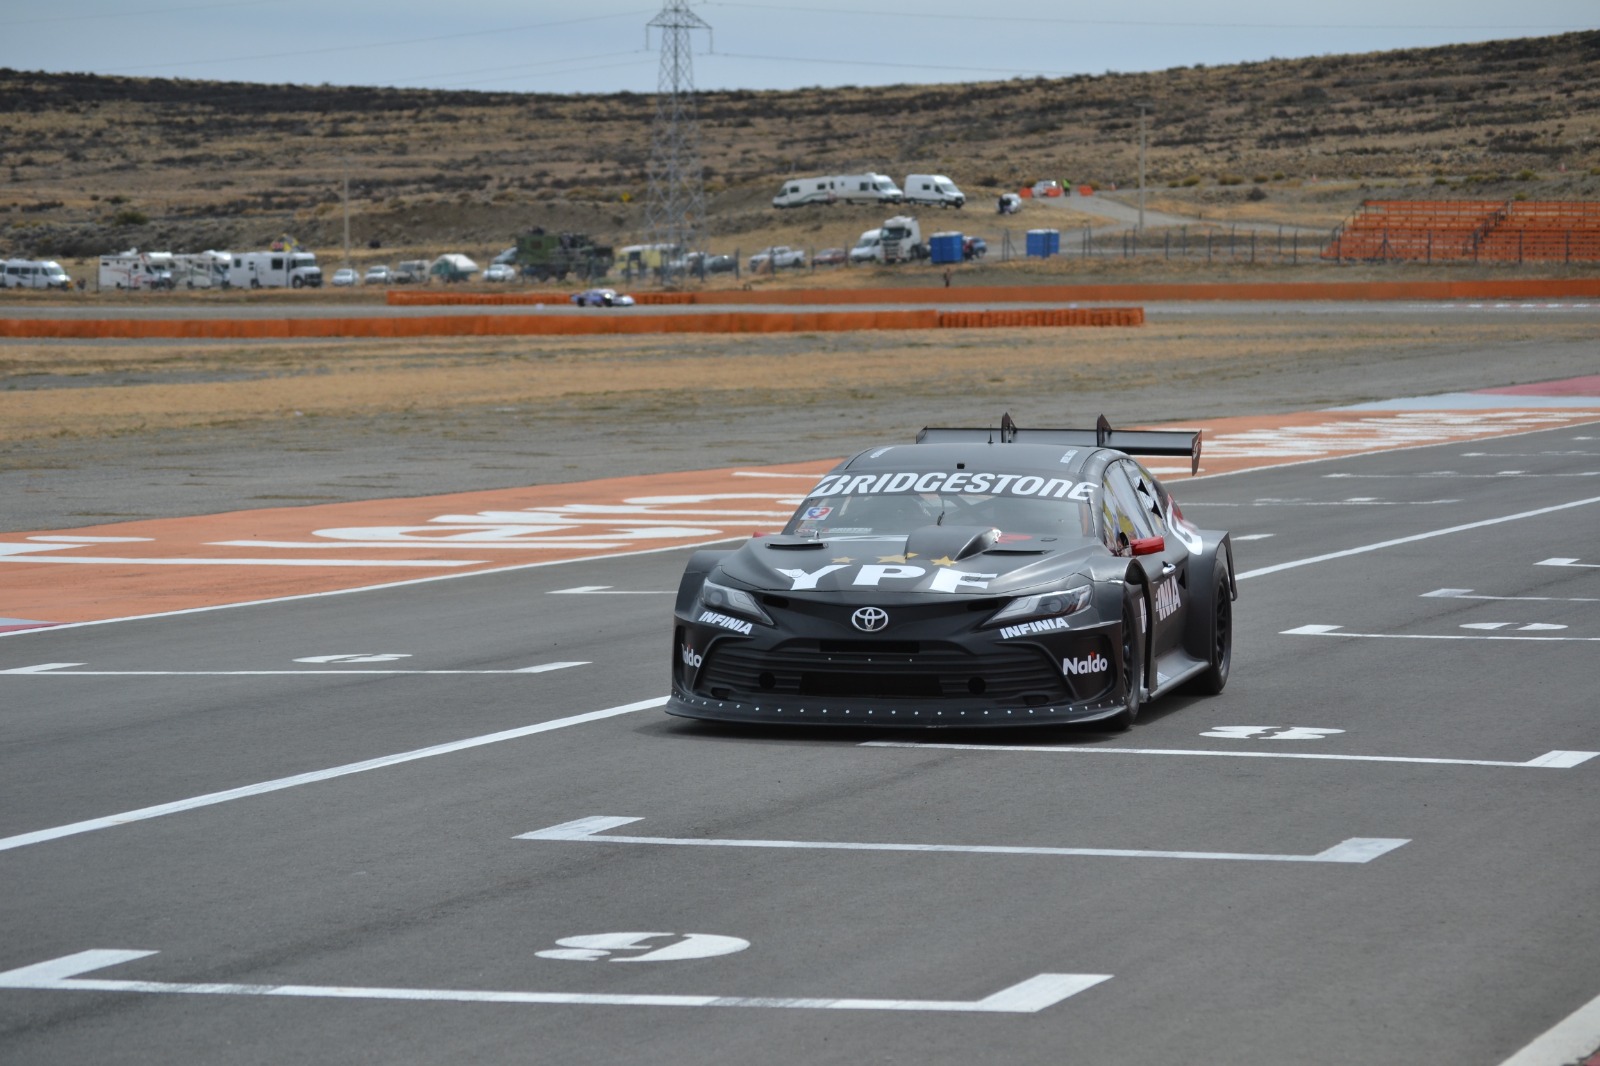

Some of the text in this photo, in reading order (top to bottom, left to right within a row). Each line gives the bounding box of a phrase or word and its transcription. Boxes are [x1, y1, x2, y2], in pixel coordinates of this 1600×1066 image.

[806, 472, 1099, 500] BRIDGESTONE
[775, 564, 998, 593] YPF
[698, 611, 753, 635] INFINIA
[1000, 617, 1069, 639] INFINIA
[1063, 653, 1108, 676] Naldo
